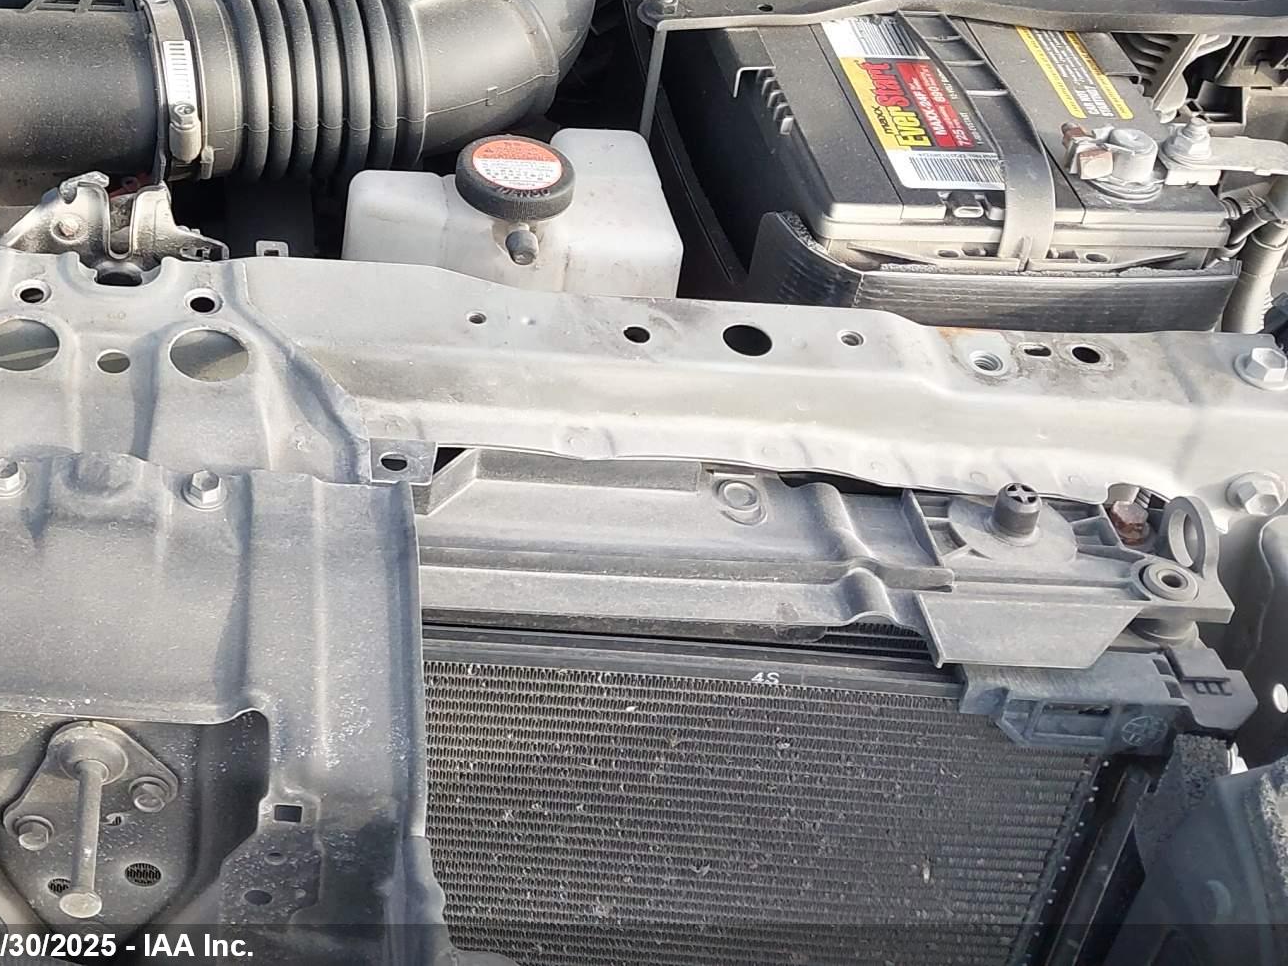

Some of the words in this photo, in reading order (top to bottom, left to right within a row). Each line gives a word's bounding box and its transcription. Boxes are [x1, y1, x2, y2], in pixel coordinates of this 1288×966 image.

[927, 86, 947, 103] 890
[859, 61, 933, 147] EverStart
[872, 105, 894, 135] maxx
[951, 128, 972, 146] 725
[751, 671, 780, 685] 4S
